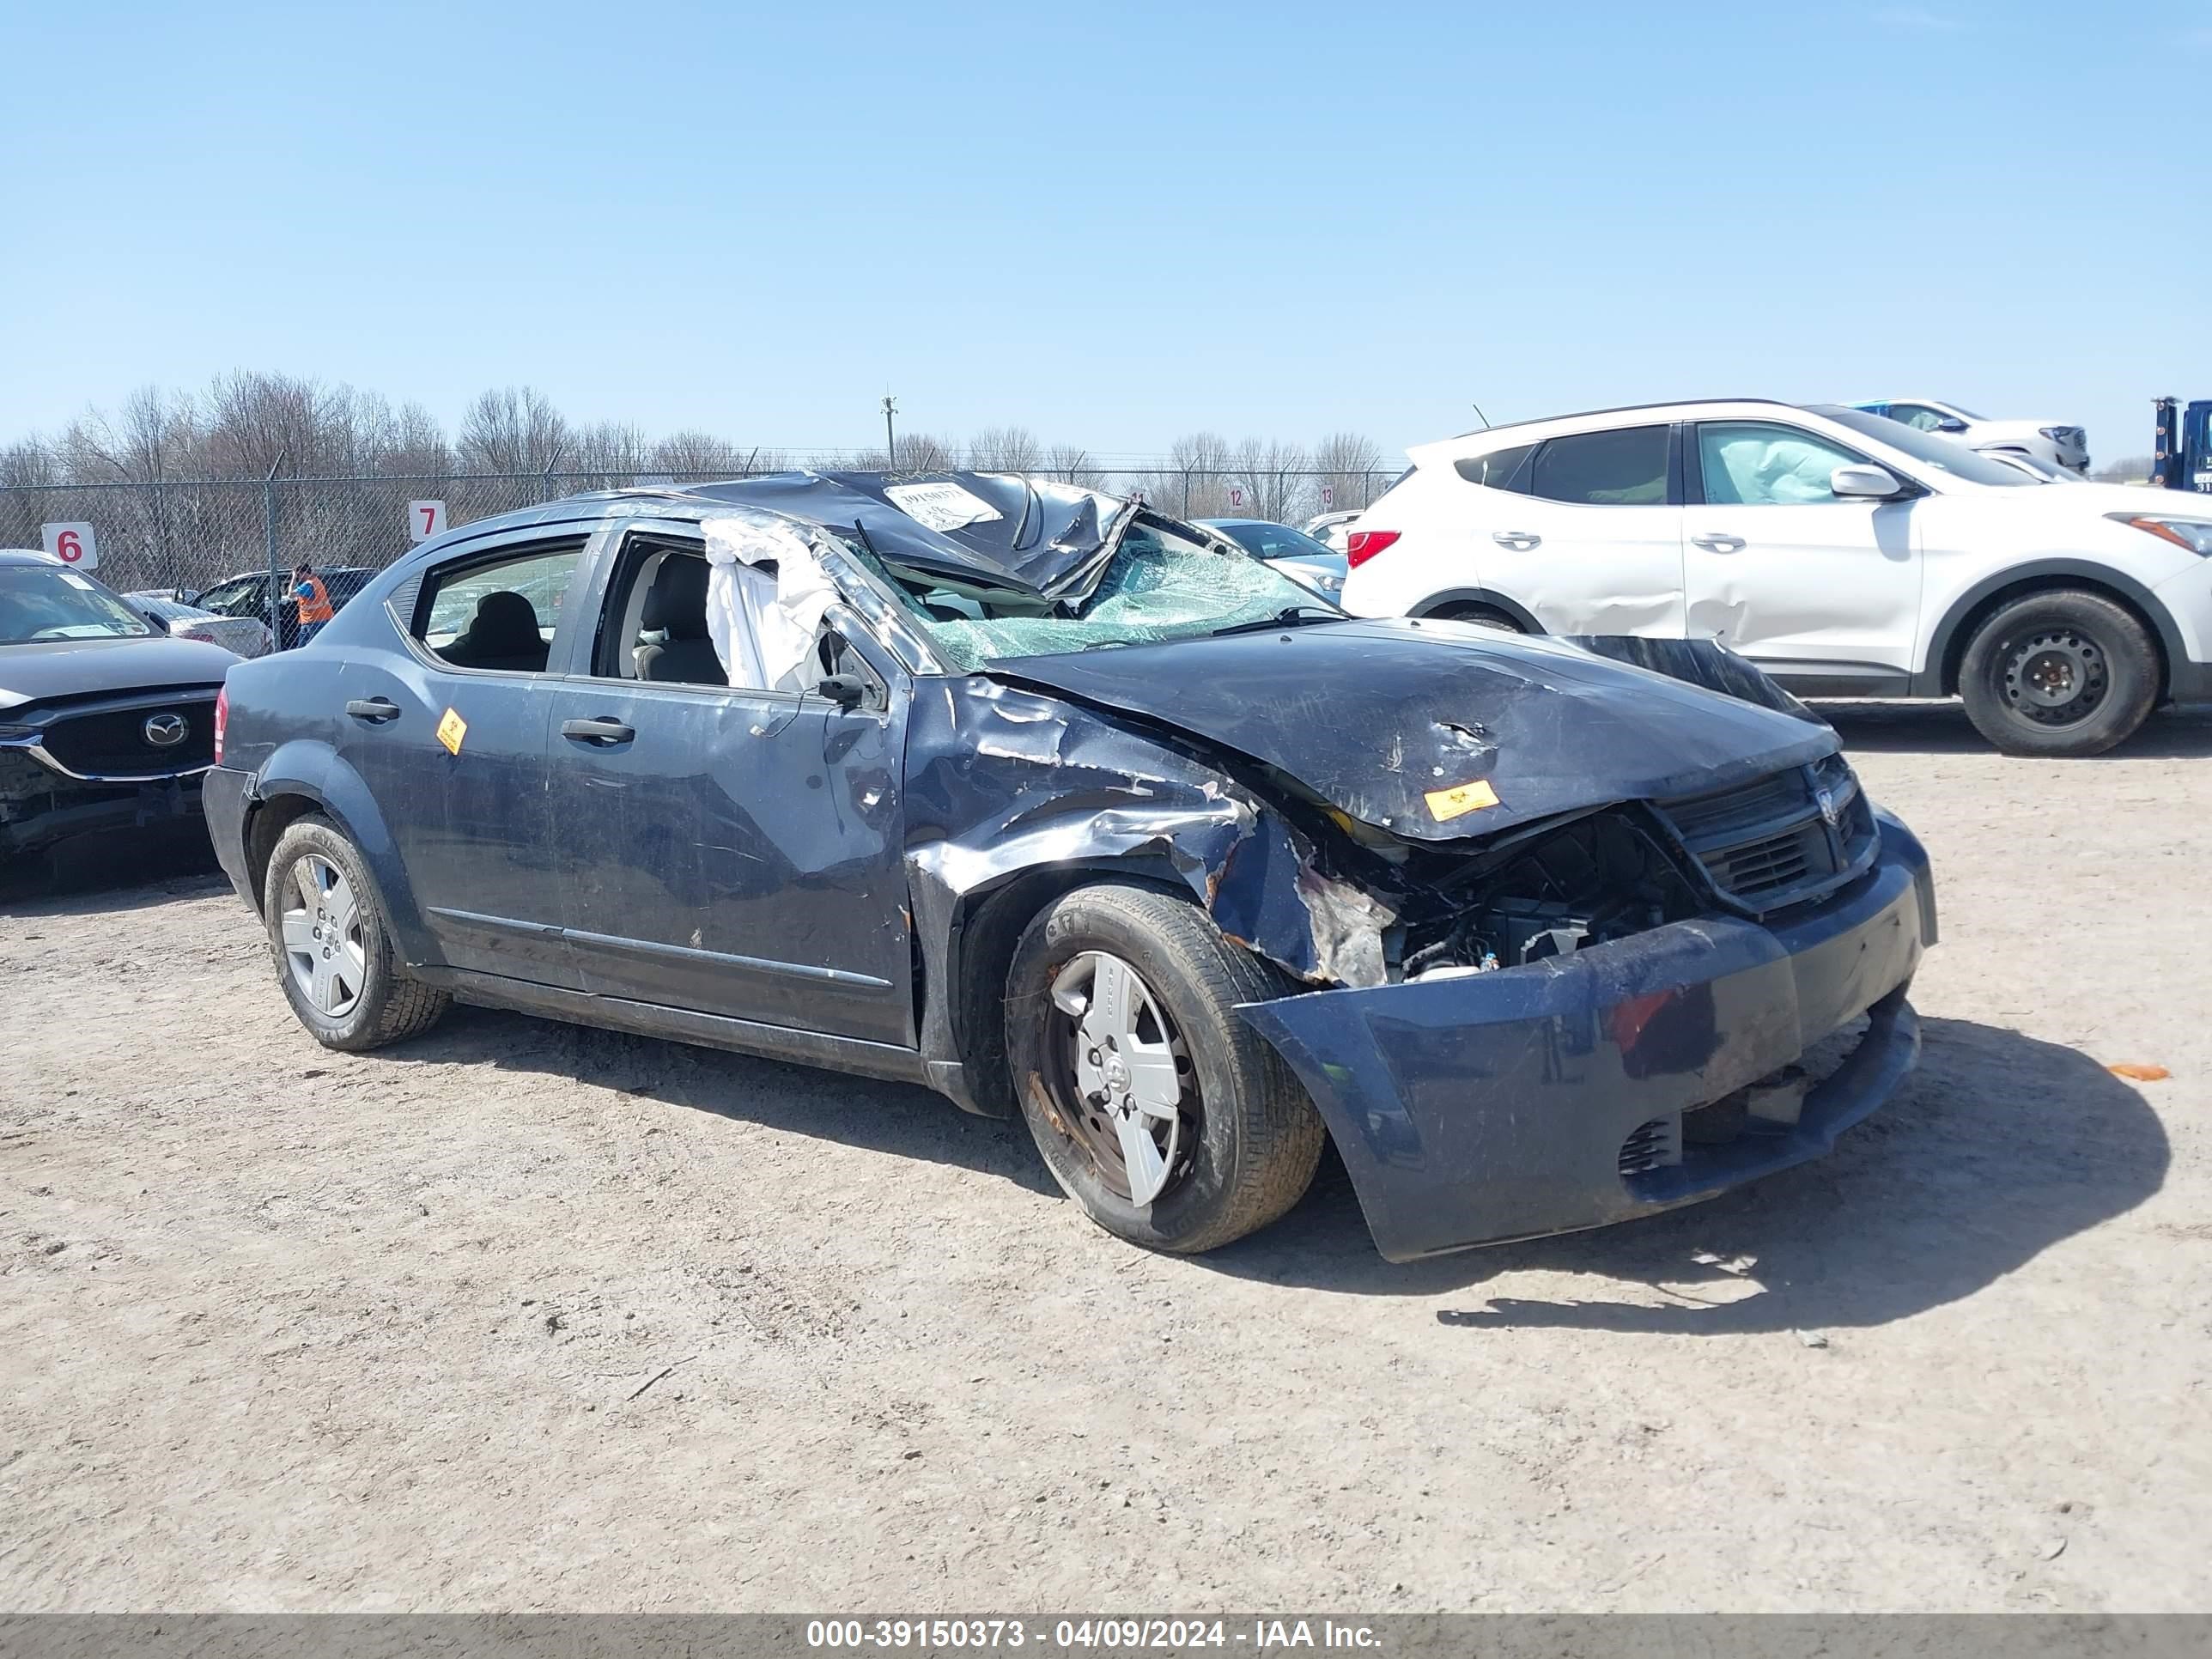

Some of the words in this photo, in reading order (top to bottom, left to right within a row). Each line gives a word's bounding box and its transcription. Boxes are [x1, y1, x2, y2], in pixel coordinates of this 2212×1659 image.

[1231, 490, 1242, 507] 12
[1322, 489, 1332, 504] 13
[419, 507, 435, 535] 7
[57, 530, 83, 563] 6
